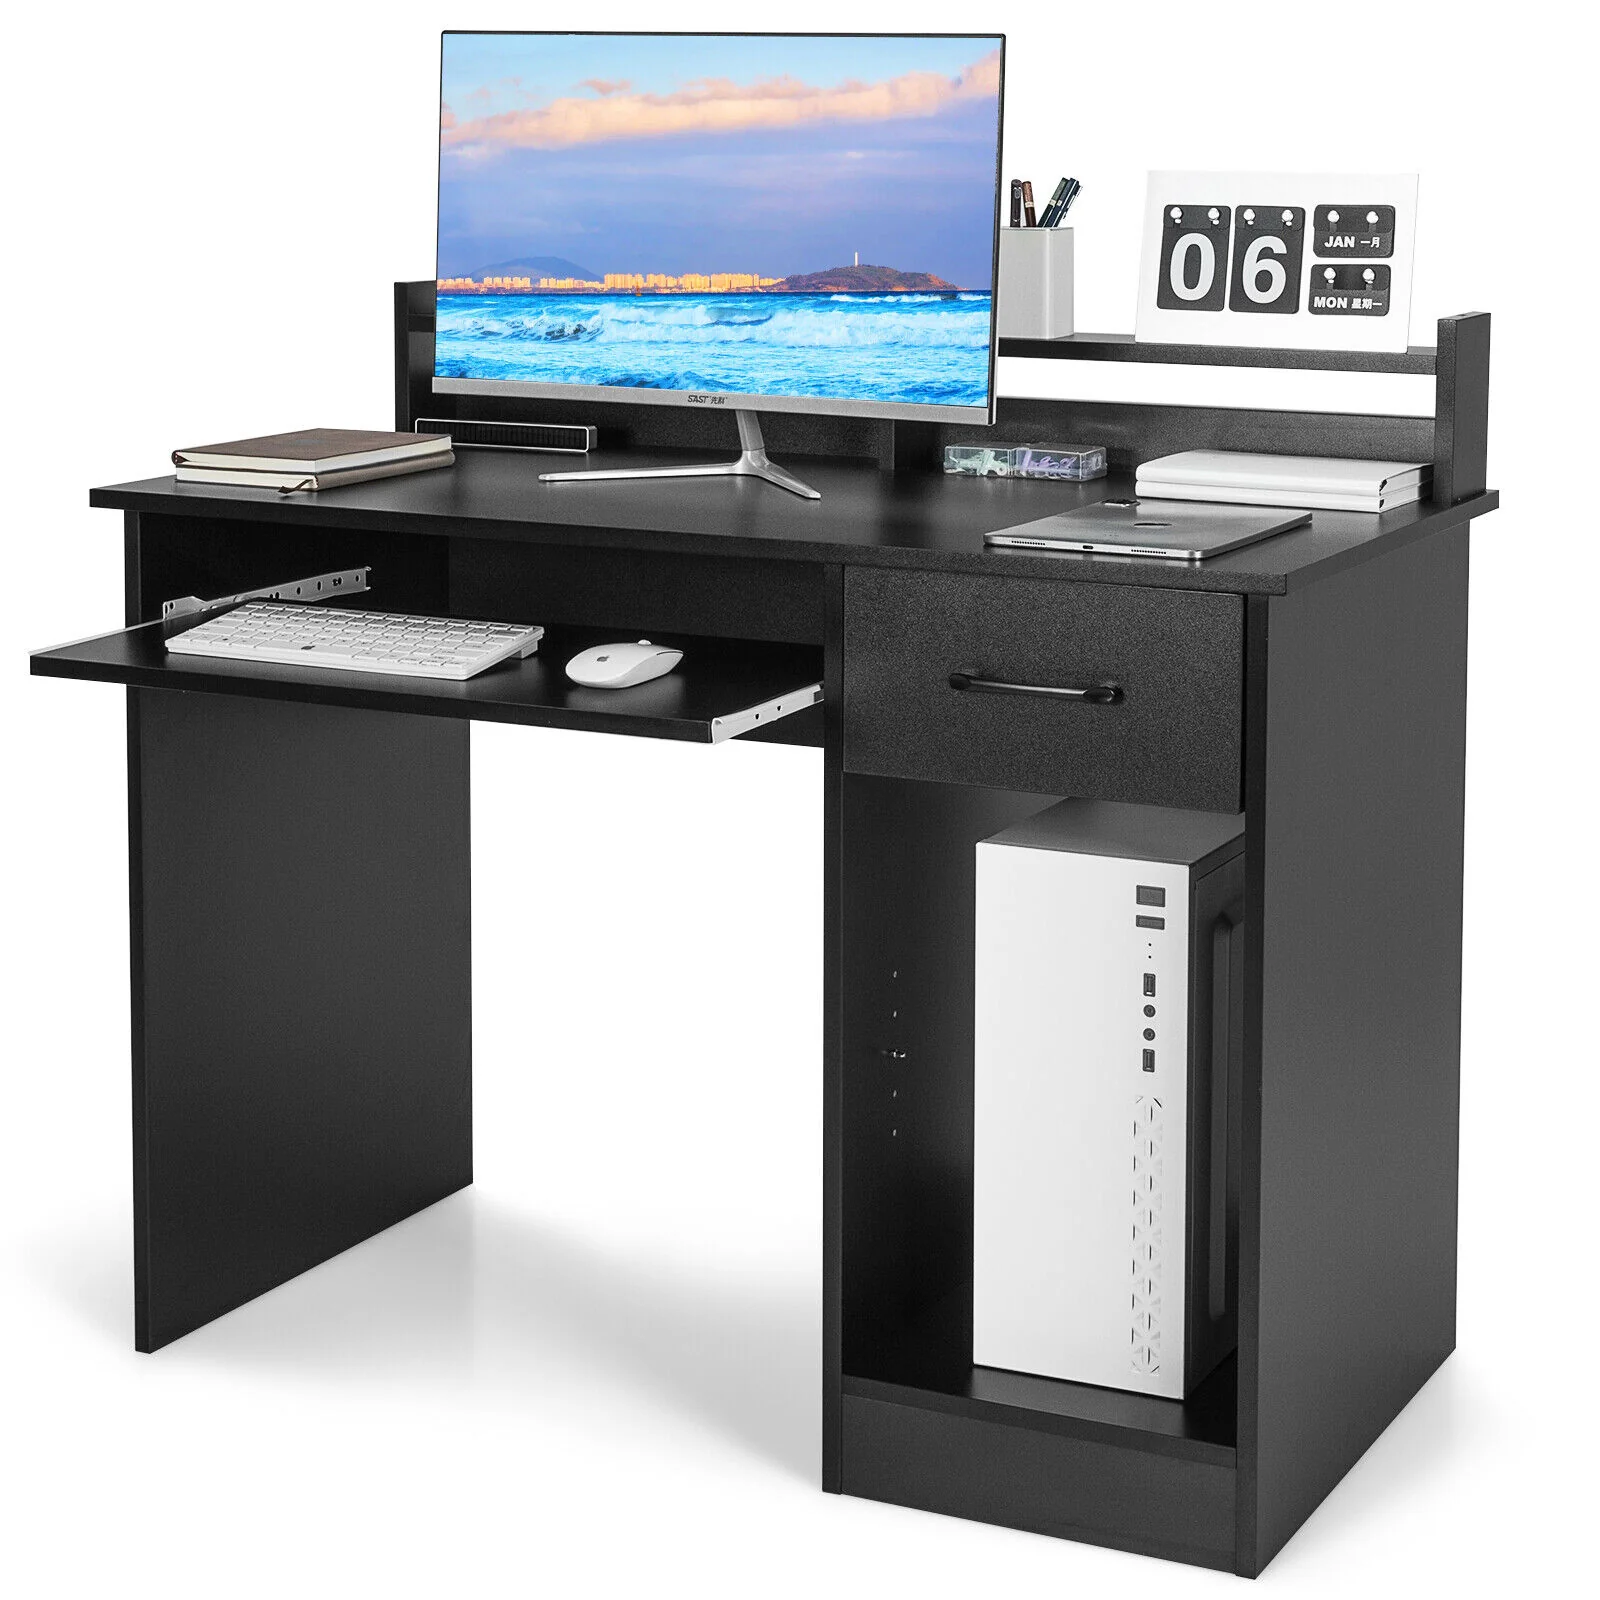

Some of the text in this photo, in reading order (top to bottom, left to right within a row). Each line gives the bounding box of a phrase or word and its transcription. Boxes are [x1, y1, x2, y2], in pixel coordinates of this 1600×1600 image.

[1324, 236, 1380, 248] JAN 一月
[1313, 296, 1382, 309] MON 星期一
[687, 395, 708, 403] SAST
